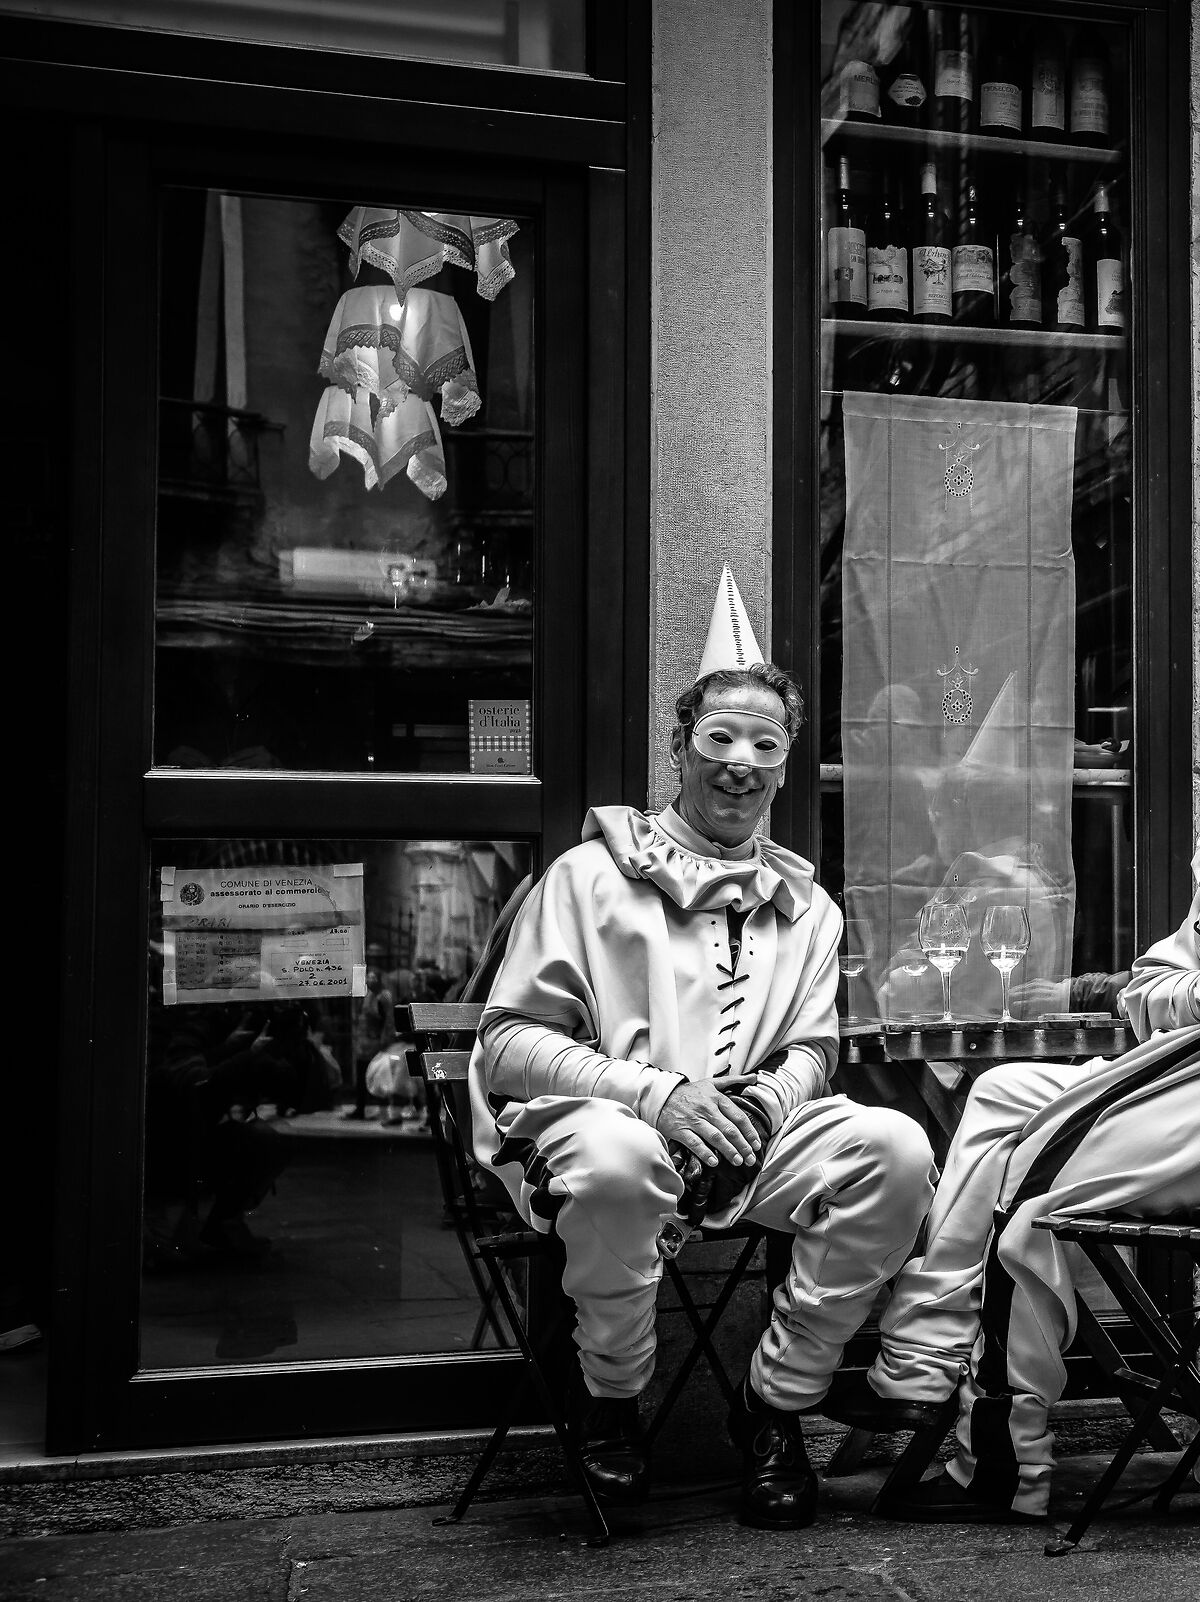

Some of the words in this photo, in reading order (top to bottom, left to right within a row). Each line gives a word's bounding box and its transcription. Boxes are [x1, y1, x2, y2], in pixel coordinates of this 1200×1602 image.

[479, 704, 520, 715] osterie
[479, 715, 521, 727] d'Italia
[220, 880, 260, 889] COMUNE
[275, 878, 313, 887] VENEZIA
[210, 889, 262, 898] assessorato
[265, 888, 273, 896] al
[275, 887, 322, 895] commercio
